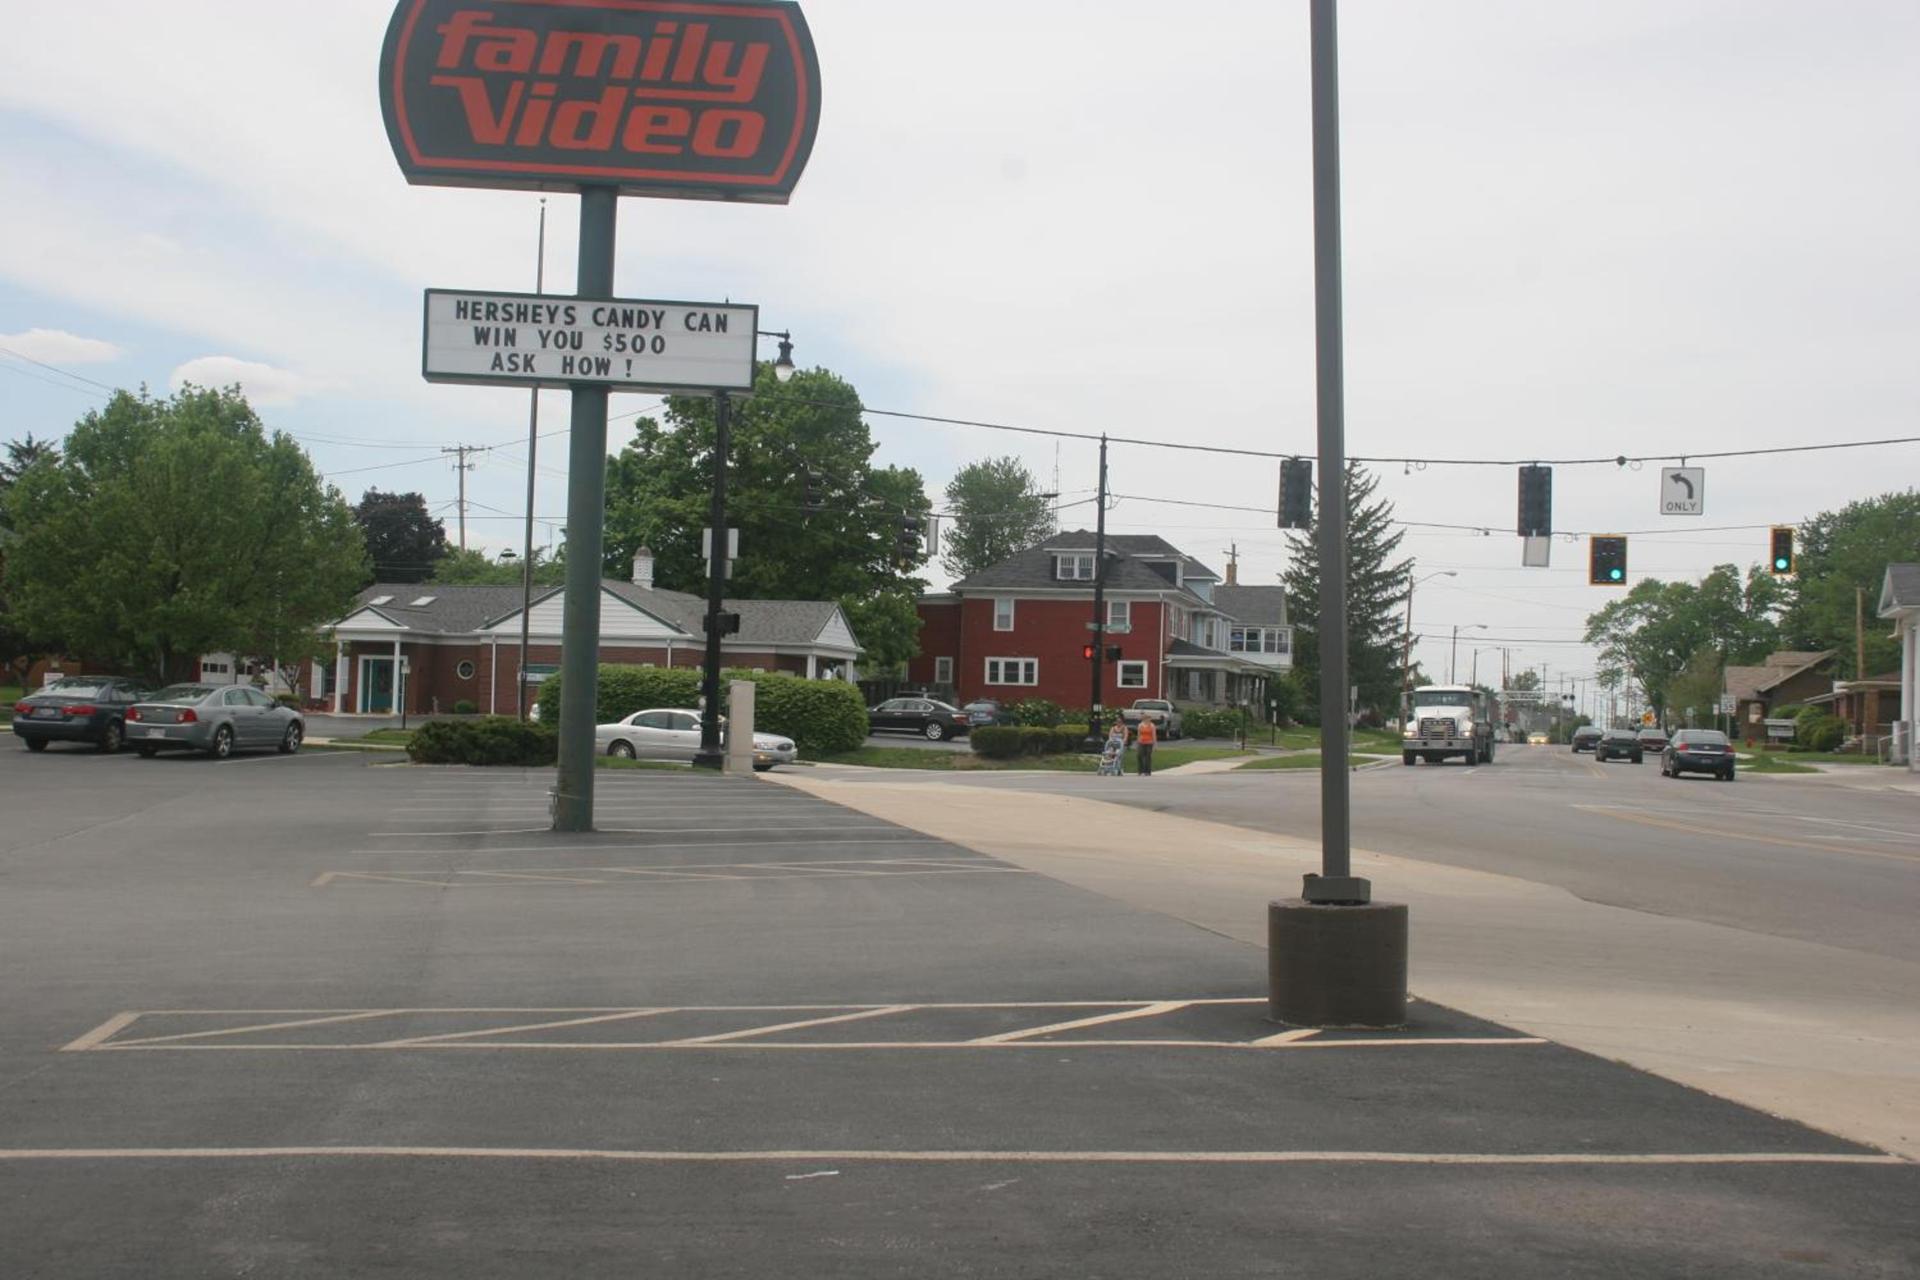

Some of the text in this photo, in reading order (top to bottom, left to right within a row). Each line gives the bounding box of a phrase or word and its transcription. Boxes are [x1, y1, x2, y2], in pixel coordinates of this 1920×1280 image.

[436, 10, 771, 103] family
[430, 75, 766, 159] Video
[456, 300, 728, 333] HERSHEYS CANDY CAN
[473, 326, 666, 354] WIN YOU $500
[490, 352, 536, 373] ASK
[1666, 502, 1696, 511] ONLY
